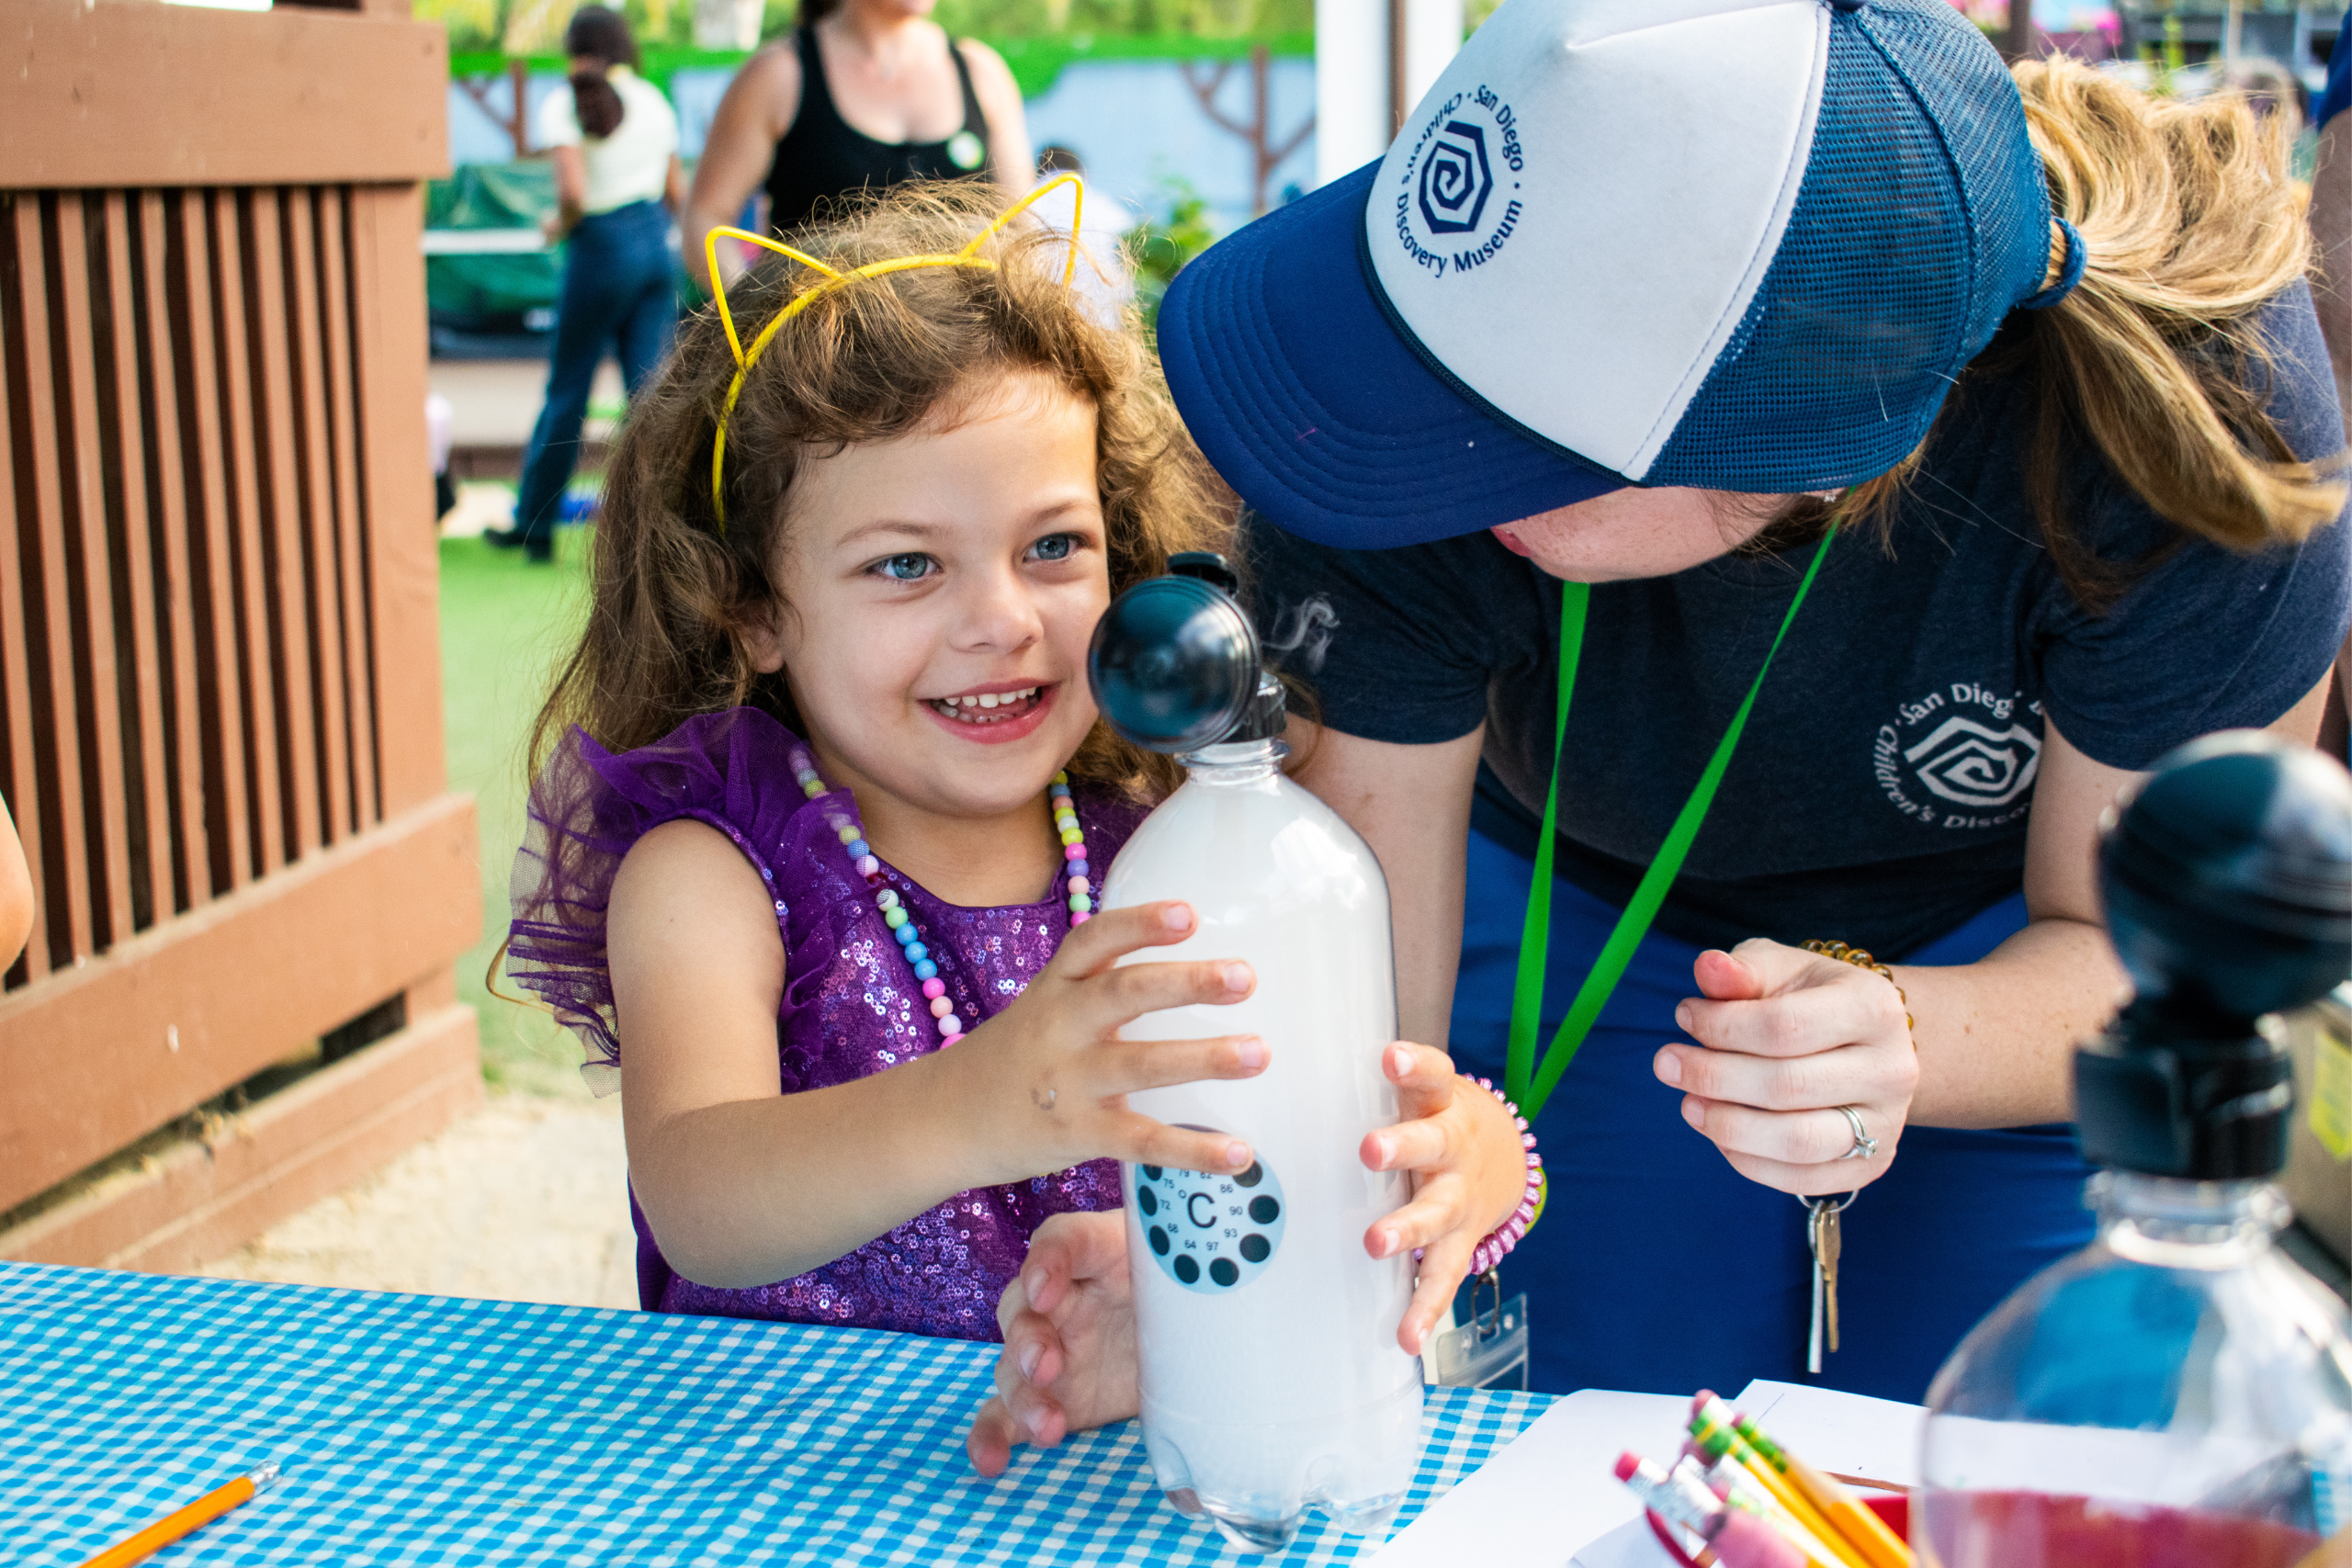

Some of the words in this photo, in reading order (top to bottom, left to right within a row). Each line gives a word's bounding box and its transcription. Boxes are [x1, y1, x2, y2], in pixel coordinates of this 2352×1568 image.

[1474, 84, 1498, 111] San
[1495, 104, 1524, 172] Diego
[1401, 93, 1462, 185] Children's
[1396, 192, 1448, 277] Discovery
[1453, 199, 1523, 273] Museum
[1899, 692, 1945, 726] San
[1950, 682, 2022, 720] Dieg
[1873, 725, 1937, 822] Children's
[1942, 801, 2030, 829] Disco
[1163, 1179, 1174, 1189] 75
[1219, 1183, 1233, 1193] 86
[1159, 1199, 1170, 1211] 72
[1229, 1205, 1243, 1215] 90
[1224, 1228, 1238, 1238] 93
[1184, 1239, 1196, 1249] 64
[1205, 1241, 1219, 1251] 97
